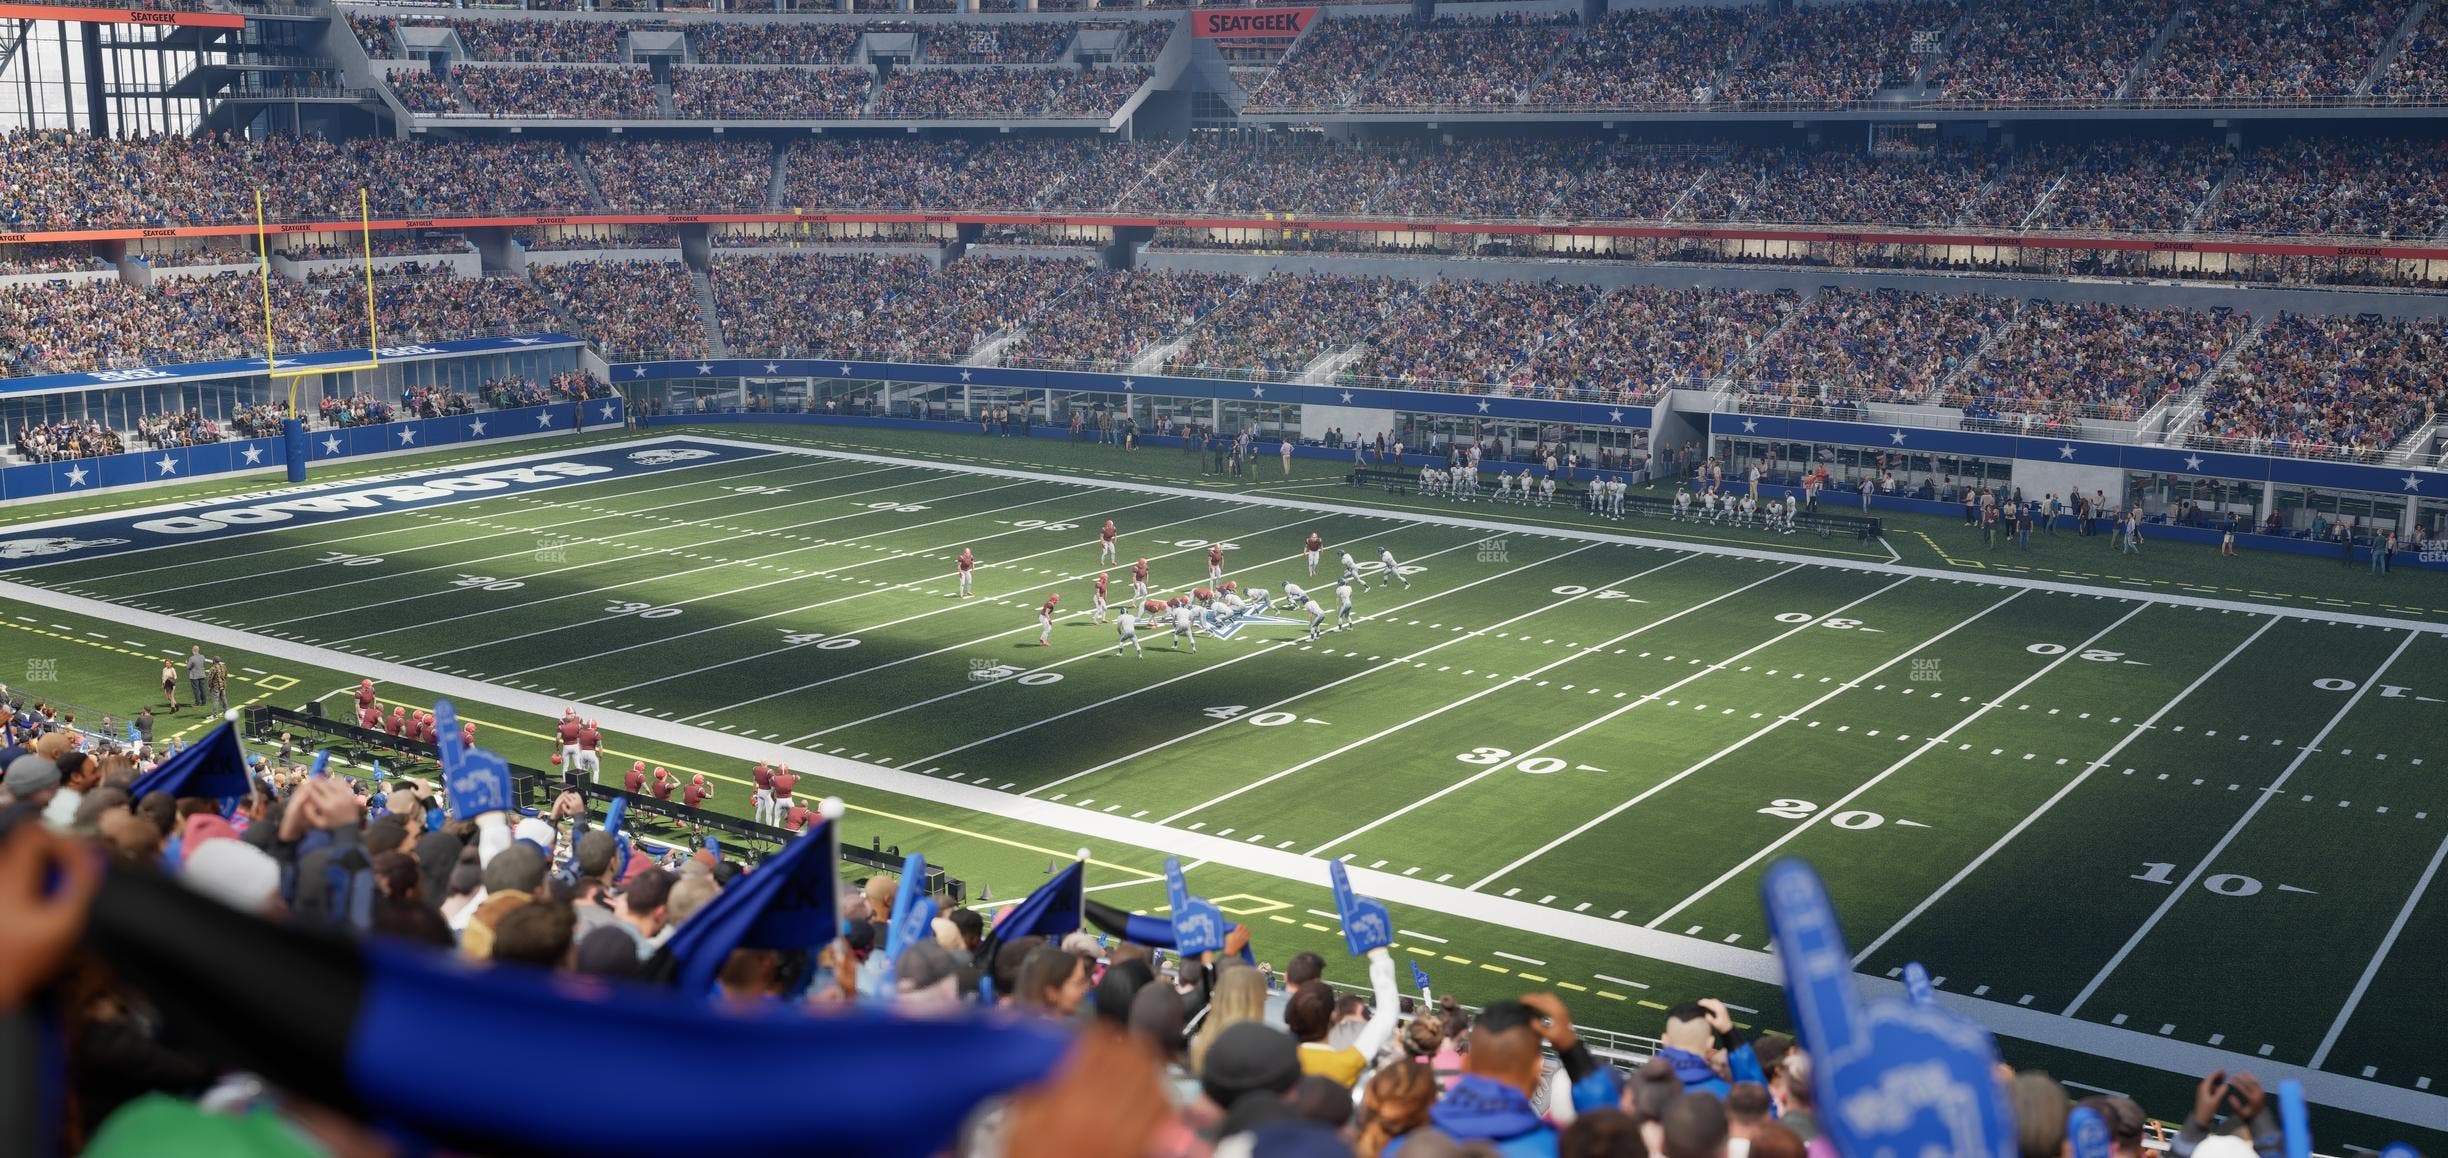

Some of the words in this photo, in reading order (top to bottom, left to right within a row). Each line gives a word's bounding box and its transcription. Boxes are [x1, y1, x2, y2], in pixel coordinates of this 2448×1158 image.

[131, 11, 176, 24] SEATGEEK
[1208, 12, 1301, 33] SEATGEEK
[143, 229, 176, 237] SEATGEEK
[1407, 223, 1437, 231] SEATGEEK
[1540, 226, 1571, 234] SEATGEEK
[1679, 229, 1712, 238] SEATGEEK
[1826, 233, 1861, 241] SEATGEEK
[1984, 237, 2021, 245] SEATGEEK
[2154, 241, 2194, 251] SEATGEEK
[2336, 246, 2381, 257] SEATGEEK
[131, 461, 614, 534] COWBOYS
[447, 576, 526, 591] 20
[1551, 585, 1631, 599] 40
[604, 602, 683, 619] 30
[1773, 612, 1864, 629] 30
[781, 633, 862, 650] 40
[2025, 643, 2126, 662] 20
[973, 664, 1065, 686] 50
[2312, 677, 2414, 698] 10
[1201, 705, 1297, 726] 40
[1455, 747, 1568, 774] 30
[1755, 798, 1885, 830] 20
[2129, 862, 2264, 897] 10
